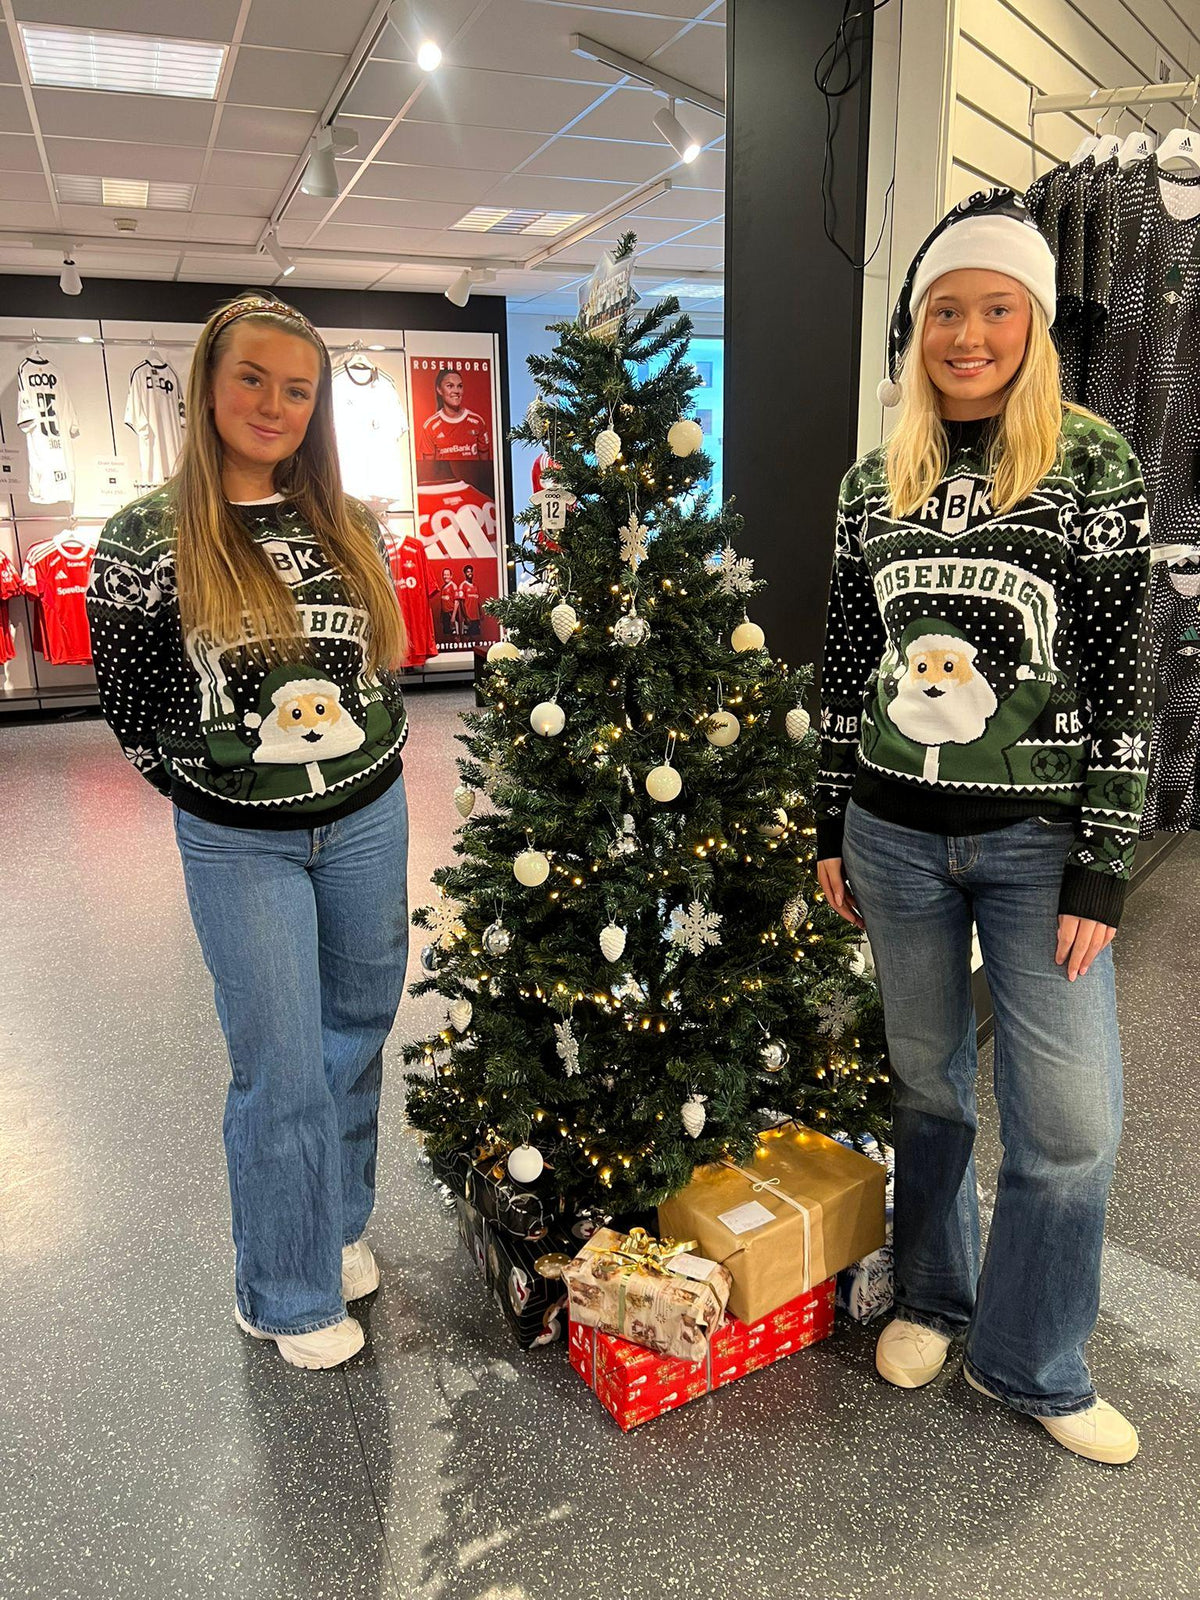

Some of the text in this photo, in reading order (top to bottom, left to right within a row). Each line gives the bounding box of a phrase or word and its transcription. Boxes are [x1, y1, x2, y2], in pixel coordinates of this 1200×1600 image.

[413, 360, 488, 371] ROSENBORG
[28, 373, 57, 389] coop
[546, 501, 559, 519] 12
[920, 490, 992, 520] RBK
[271, 549, 320, 571] BK
[876, 564, 1038, 606] ROSENBORG
